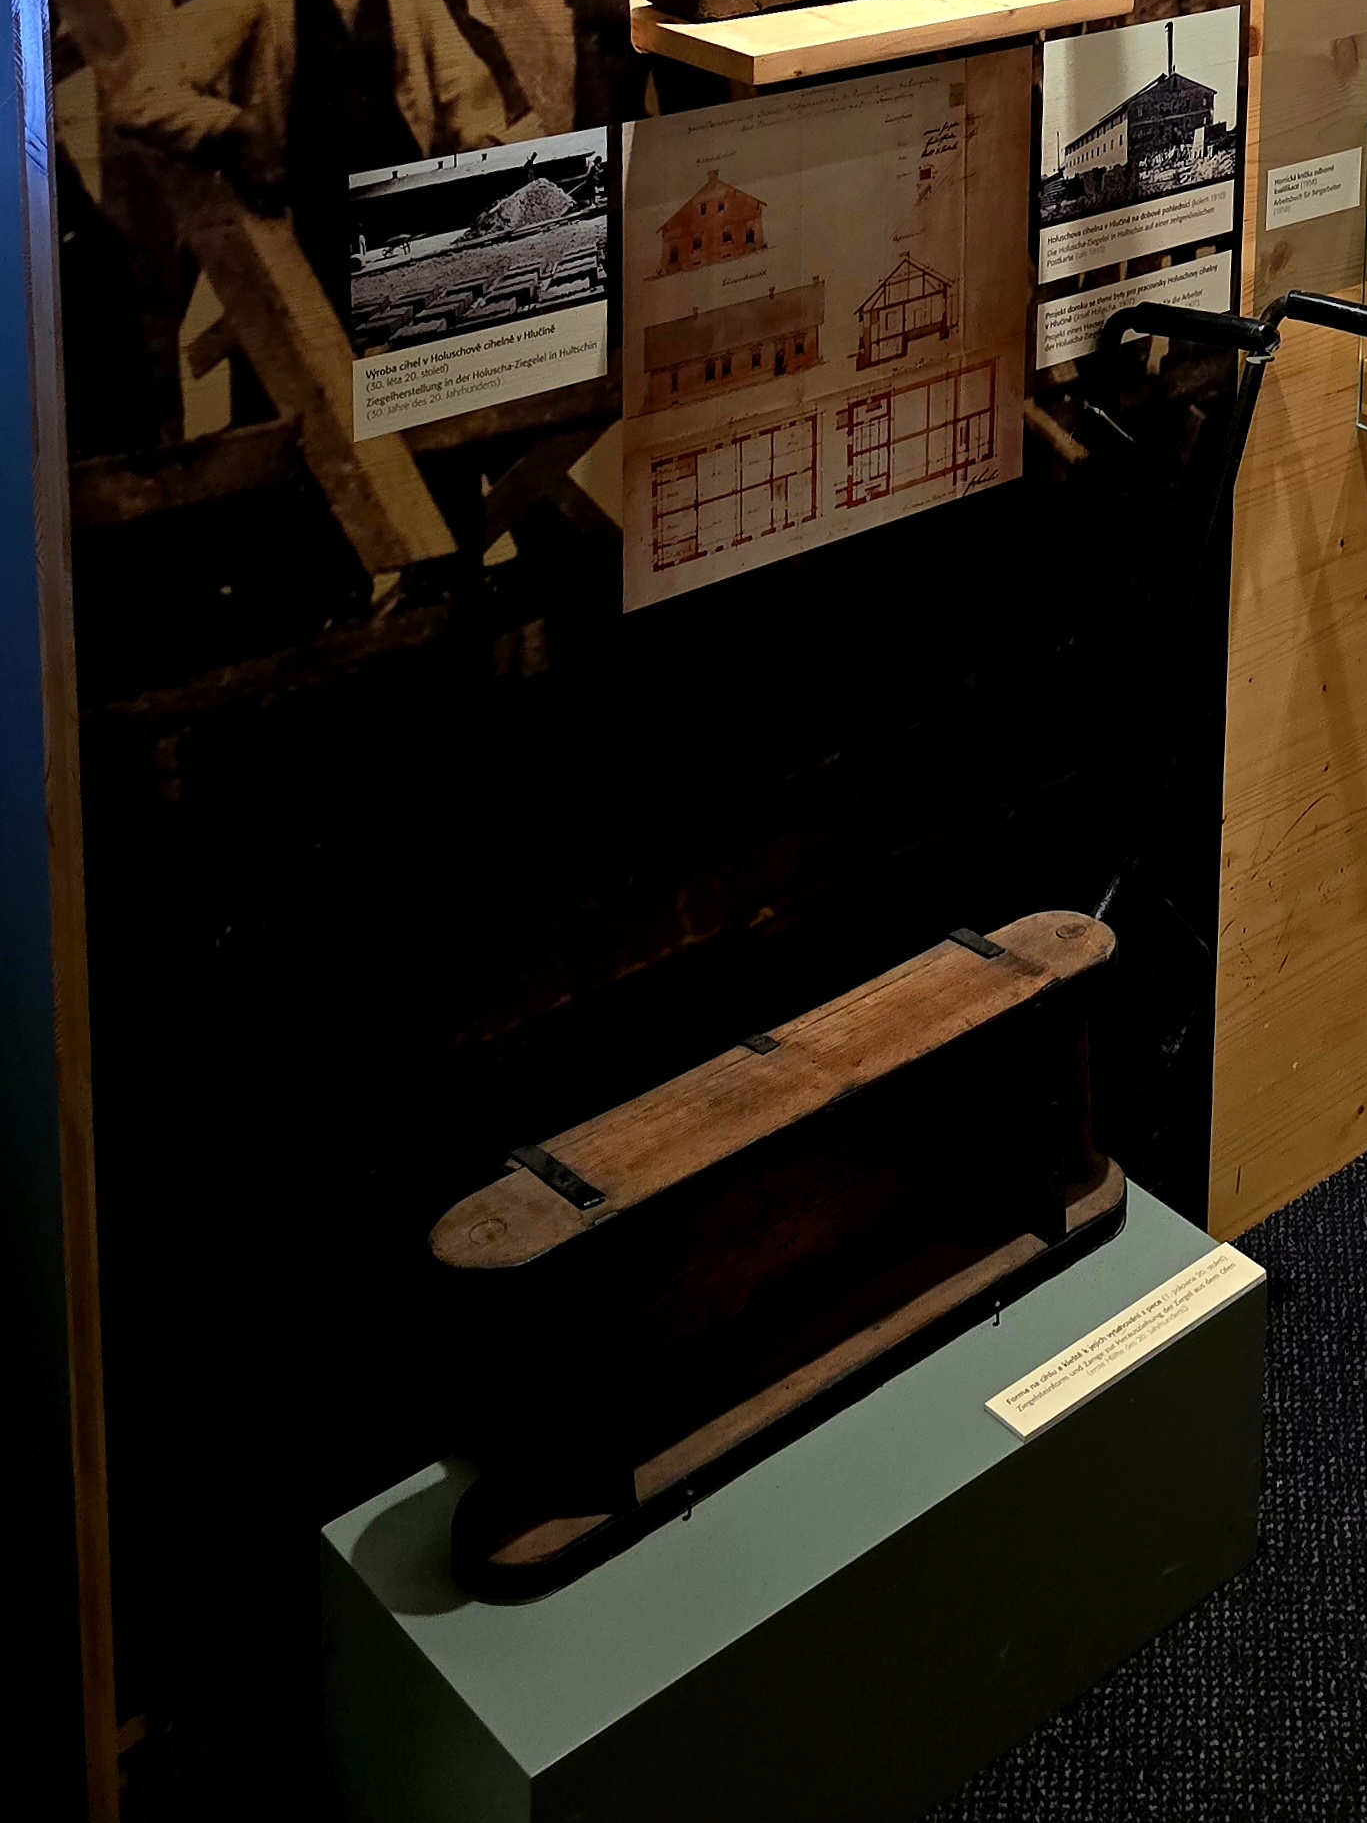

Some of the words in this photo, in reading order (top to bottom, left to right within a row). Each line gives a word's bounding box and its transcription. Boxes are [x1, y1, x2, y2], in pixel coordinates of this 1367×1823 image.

[400, 357, 421, 371] cihel
[367, 382, 442, 407] Ziegelherstellung
[445, 378, 453, 387] in
[456, 374, 470, 384] der
[549, 352, 557, 360] in
[405, 371, 418, 383] 20.
[412, 398, 427, 408] des
[430, 393, 443, 404] 20.
[1006, 1388, 1030, 1405] Forma
